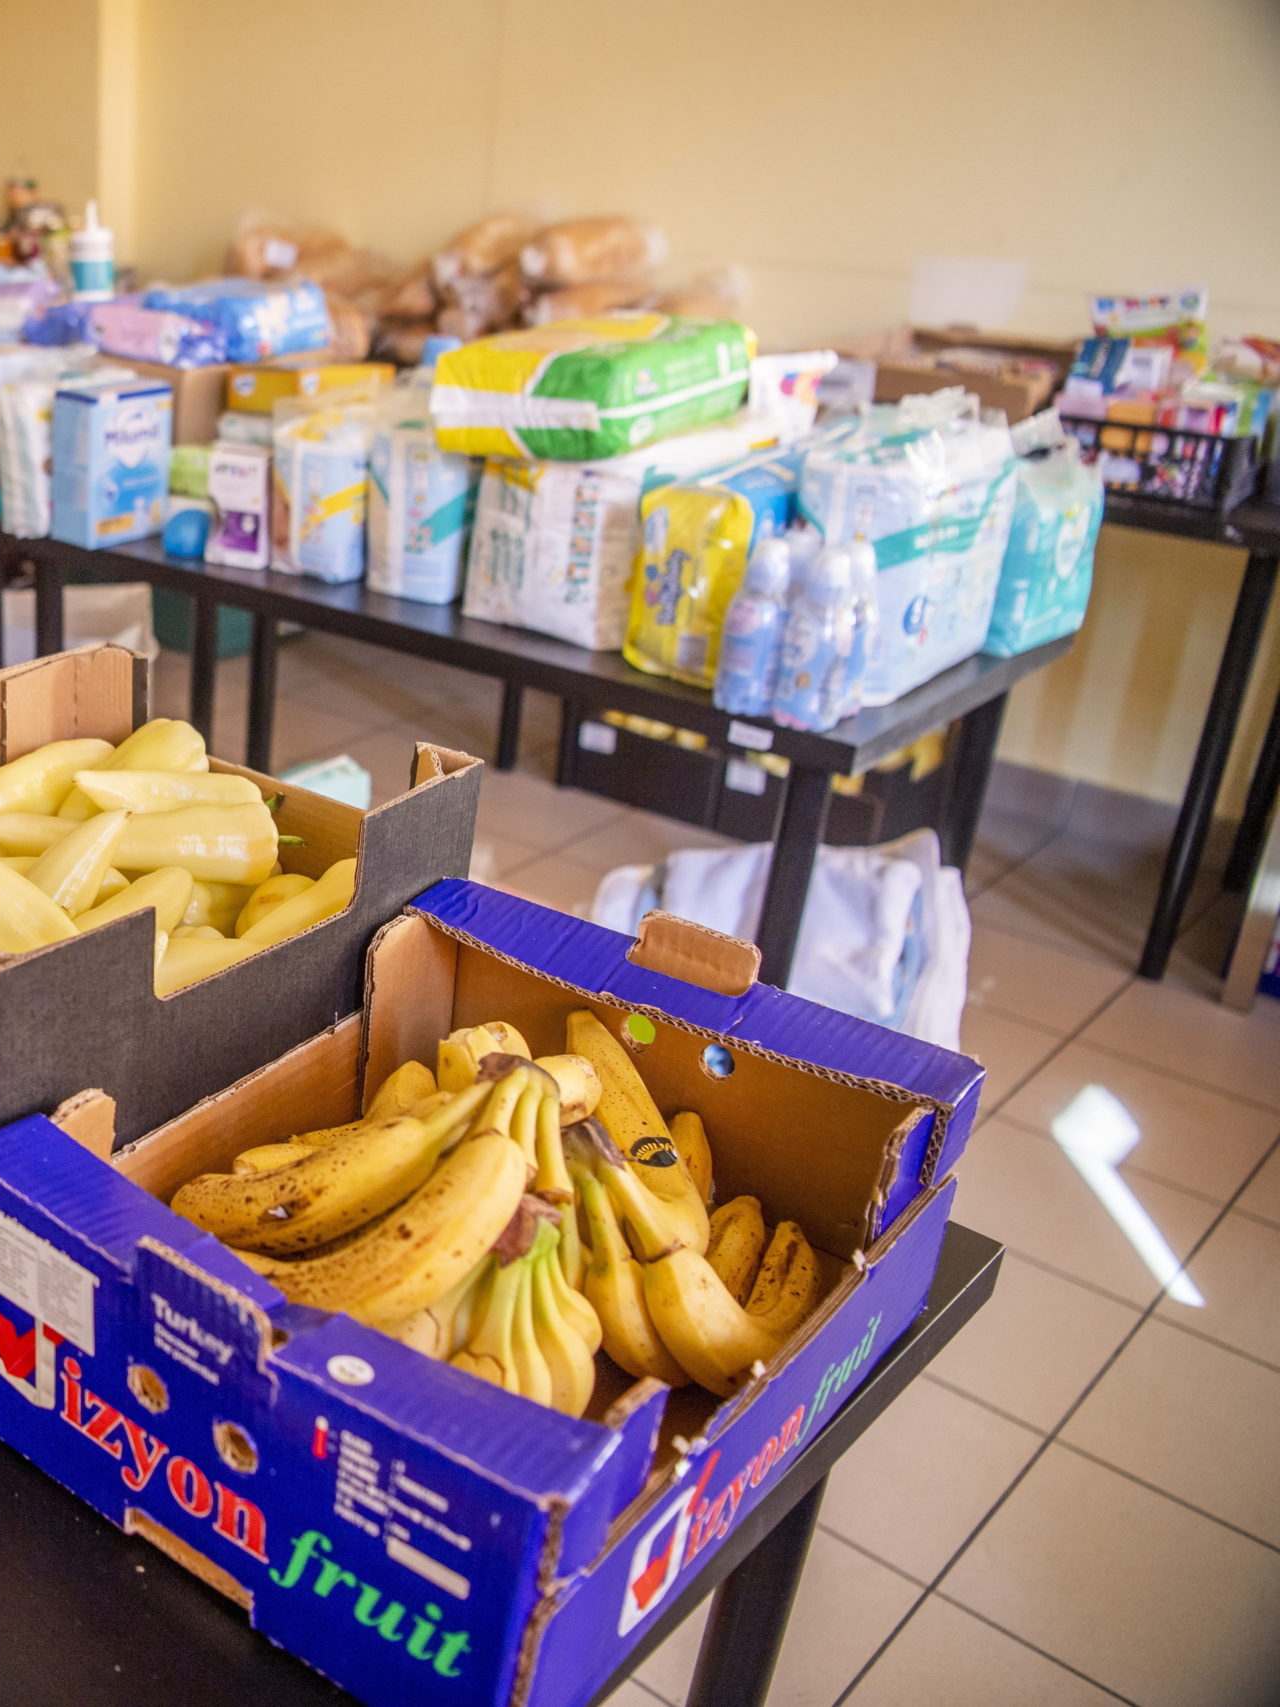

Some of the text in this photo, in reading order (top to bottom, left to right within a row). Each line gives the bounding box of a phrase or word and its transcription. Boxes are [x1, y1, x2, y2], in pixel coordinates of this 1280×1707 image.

[150, 1291, 234, 1366] Turkey
[795, 1310, 884, 1447] fruit
[268, 1529, 472, 1678] fruit
